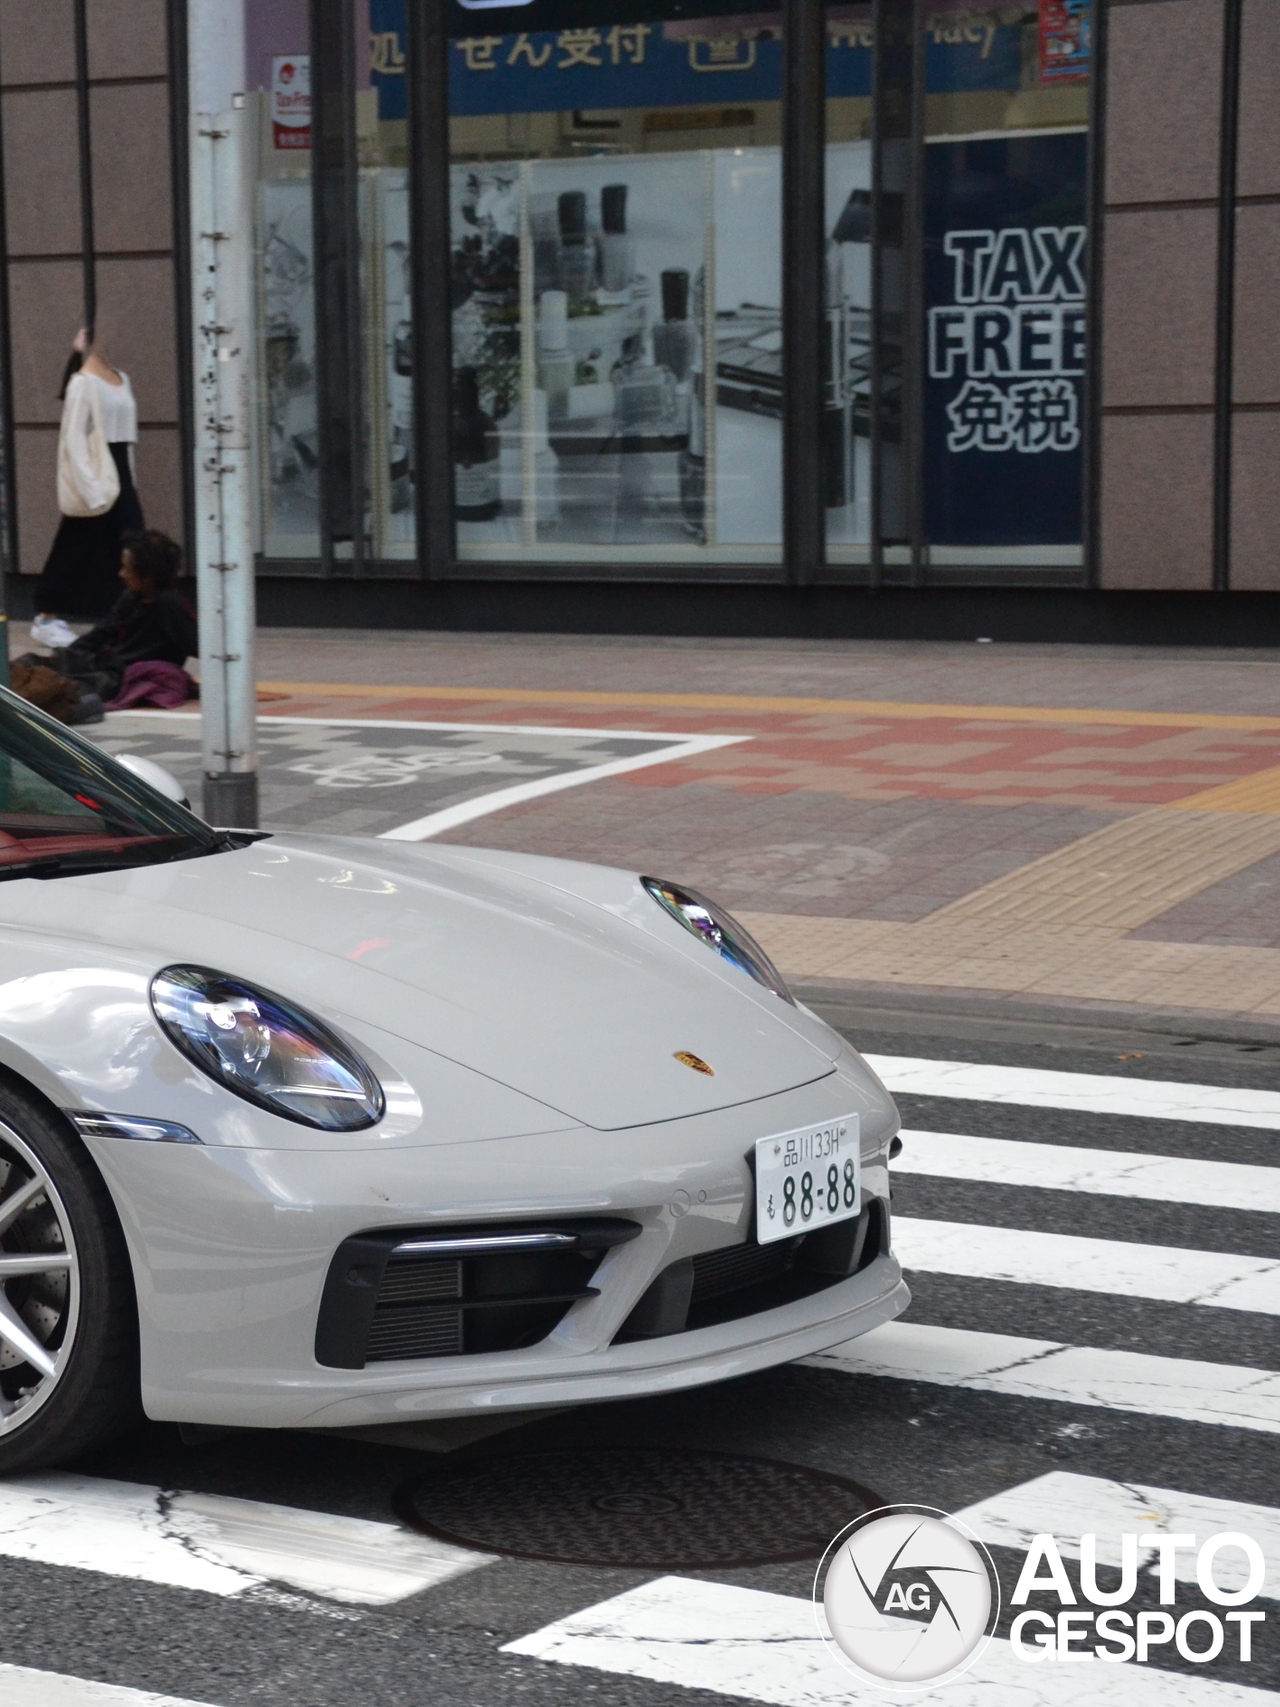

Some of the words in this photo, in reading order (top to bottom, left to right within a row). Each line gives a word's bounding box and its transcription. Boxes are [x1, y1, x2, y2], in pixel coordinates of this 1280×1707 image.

[944, 225, 1087, 303] TAX
[928, 302, 1086, 378] FREE
[946, 378, 1081, 453] 免税
[782, 1158, 856, 1228] 88-88
